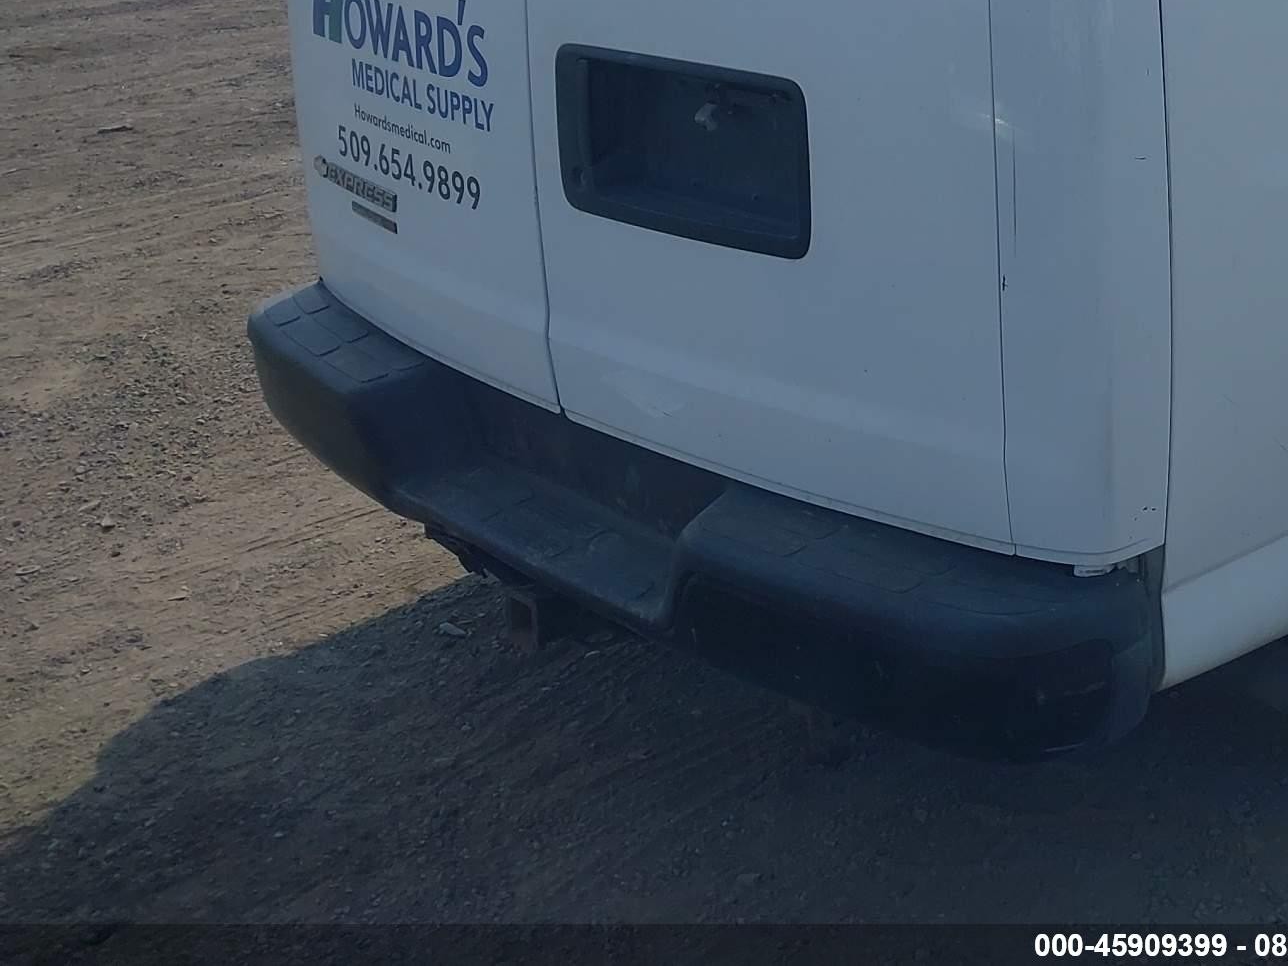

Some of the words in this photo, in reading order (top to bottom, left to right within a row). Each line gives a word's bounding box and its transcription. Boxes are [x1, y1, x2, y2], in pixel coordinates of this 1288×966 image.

[351, 58, 422, 110] MEDICAL
[427, 86, 494, 132] SUPPLY
[354, 103, 451, 154] Howardsmedical.com
[338, 125, 481, 210] 509.654.9899
